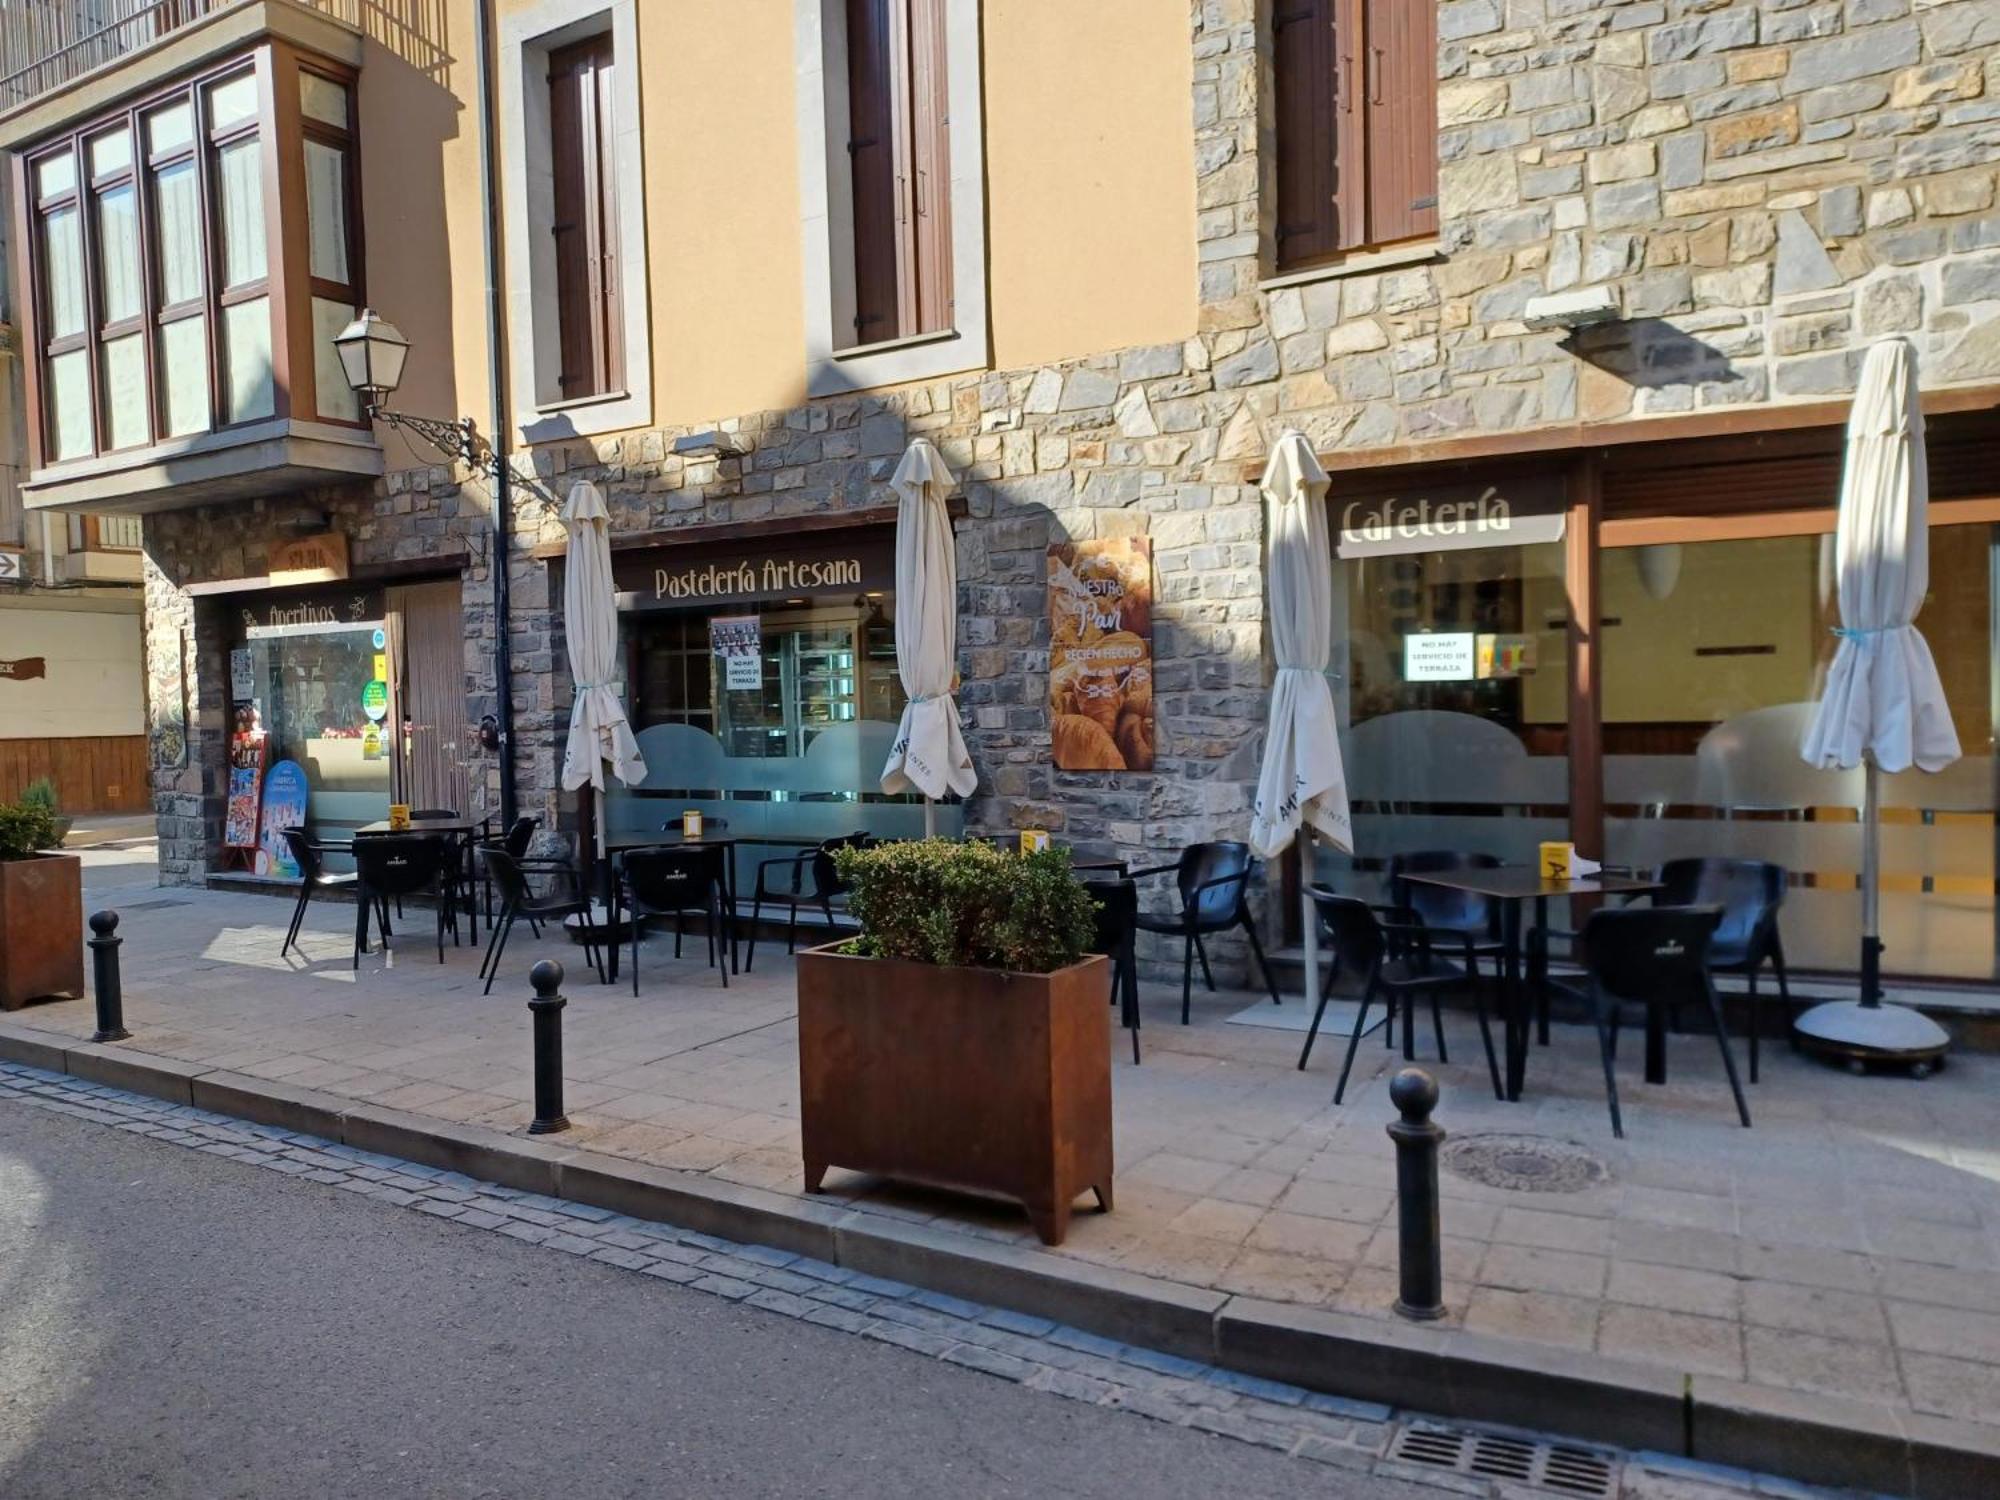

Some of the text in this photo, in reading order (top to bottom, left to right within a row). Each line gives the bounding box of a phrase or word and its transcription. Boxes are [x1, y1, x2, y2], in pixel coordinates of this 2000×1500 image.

[1342, 487, 1510, 543] Cafetería
[655, 559, 861, 599] Pastelería Artesana
[270, 601, 336, 634] Aperitivos
[1073, 601, 1123, 637] Pan
